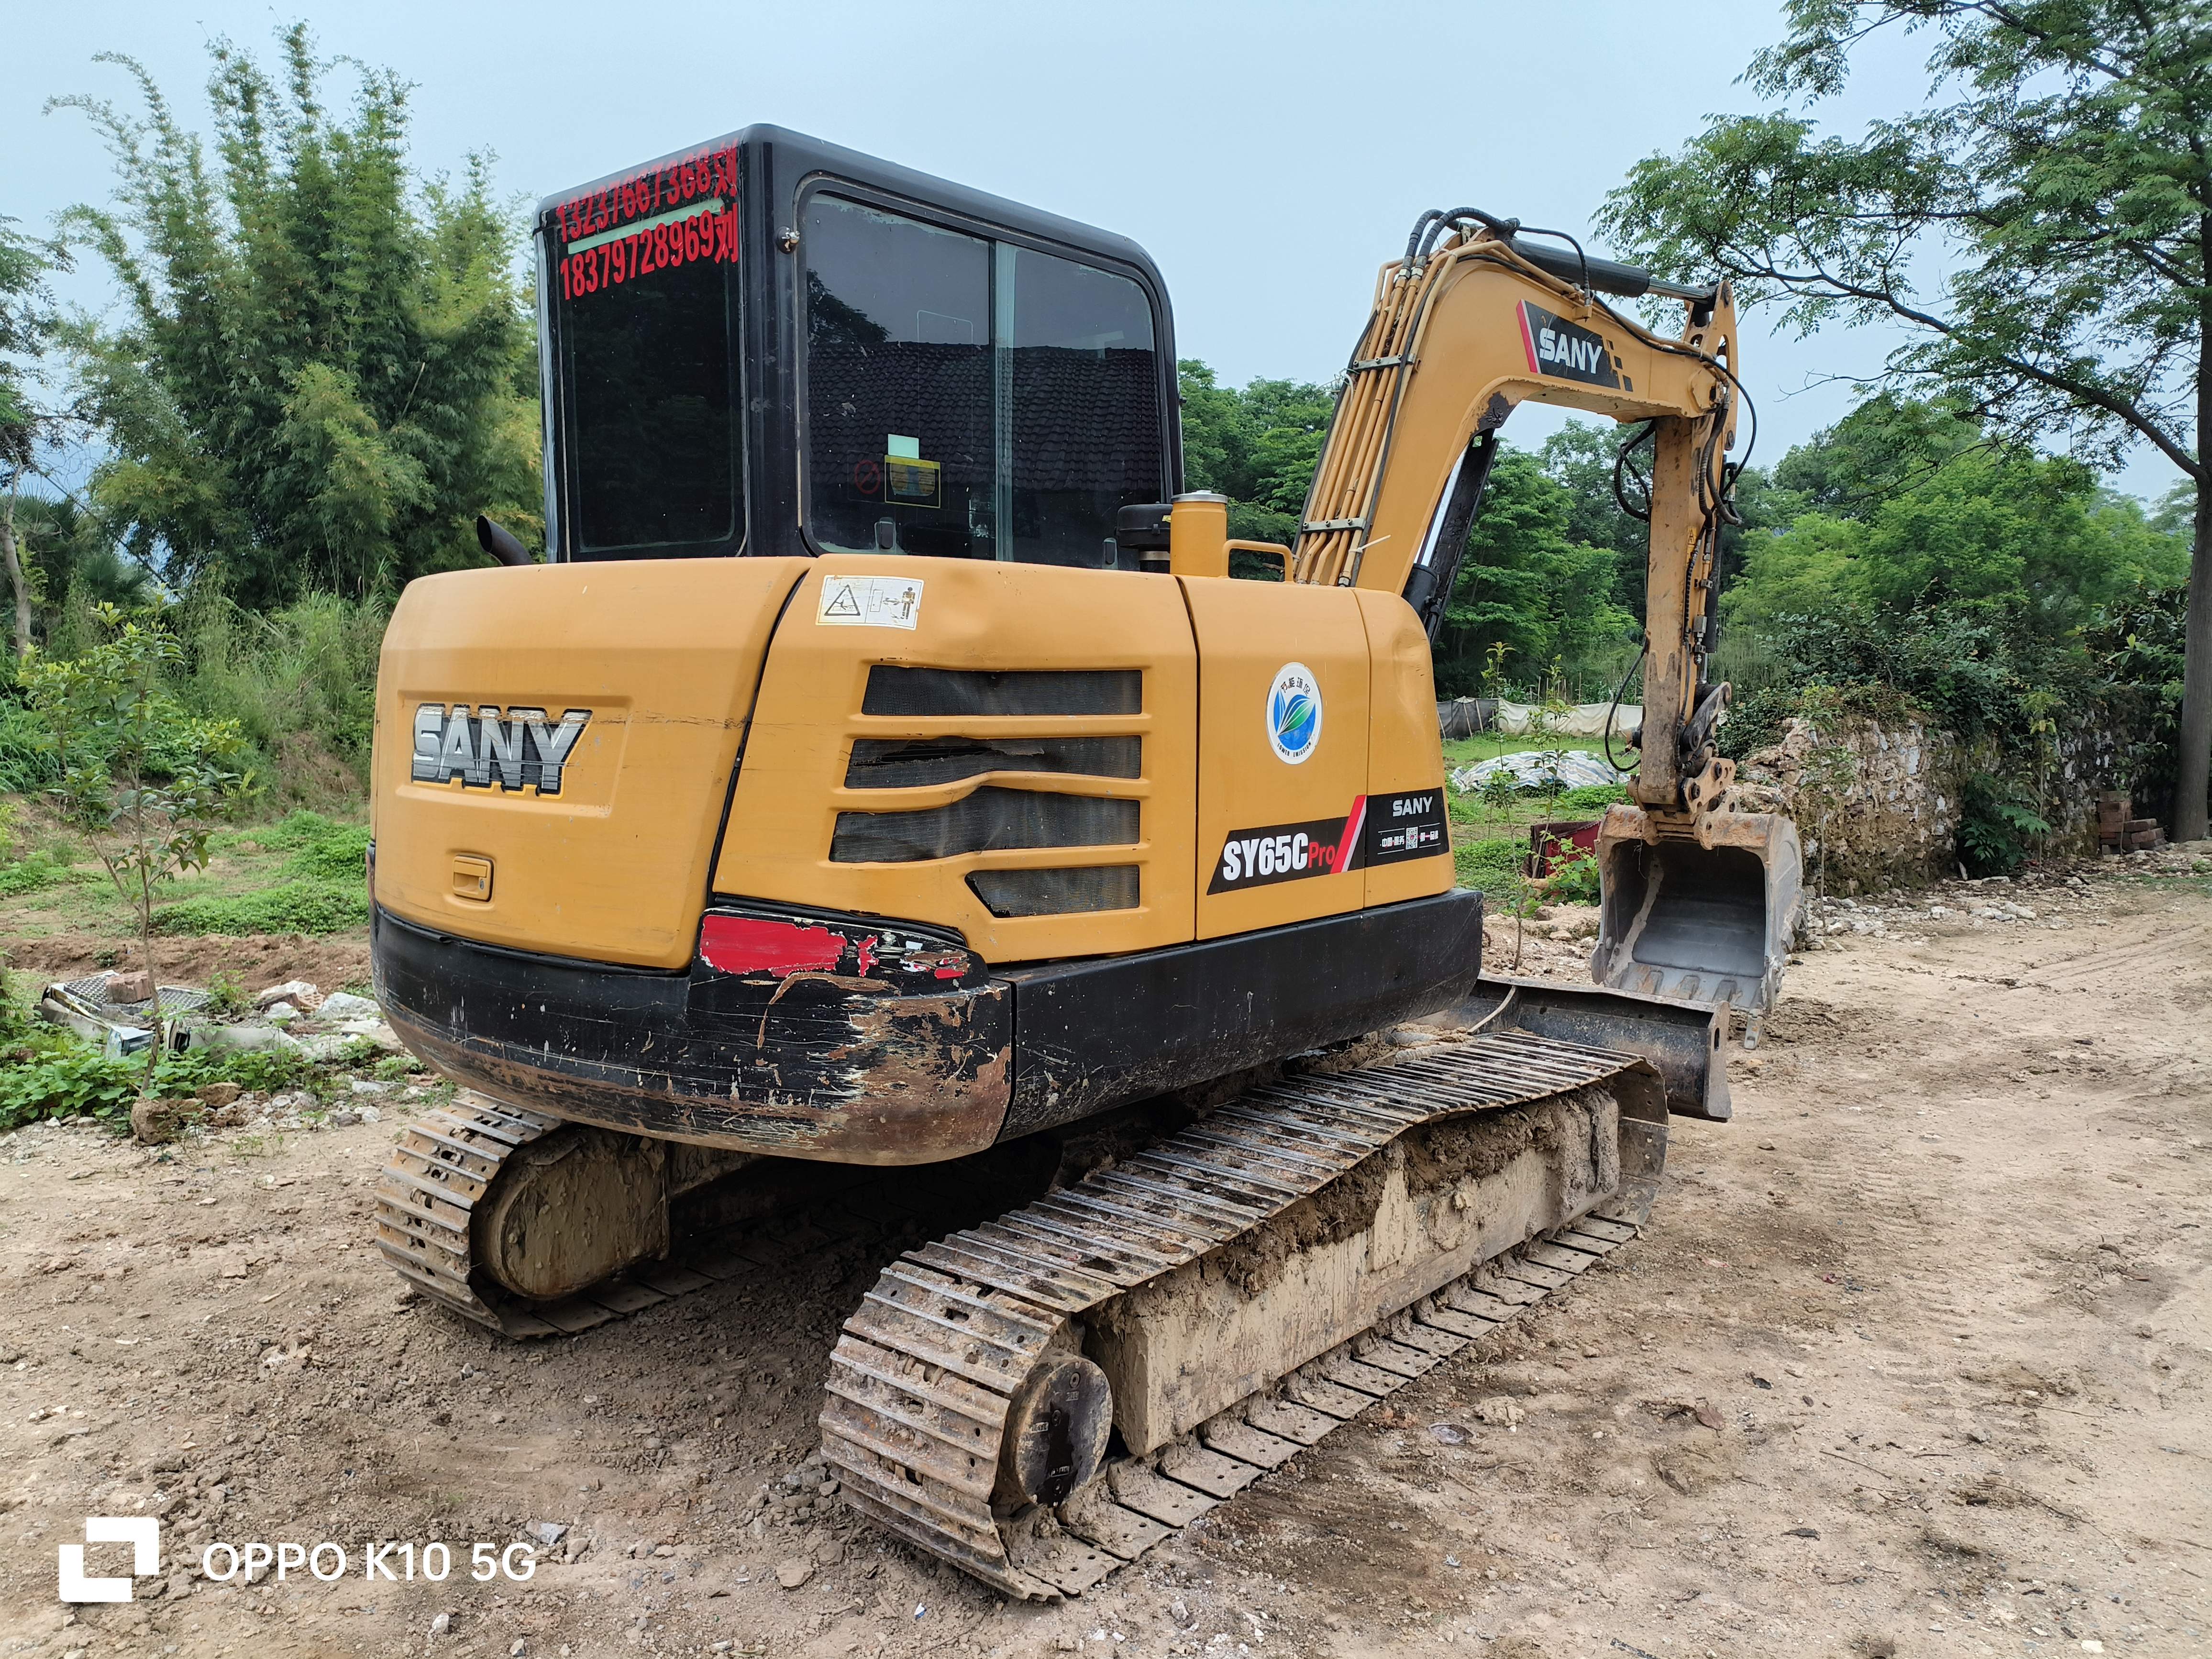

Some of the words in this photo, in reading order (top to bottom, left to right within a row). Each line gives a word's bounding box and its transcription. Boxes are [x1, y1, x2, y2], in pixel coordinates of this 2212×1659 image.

[560, 203, 739, 301] 18379728969刘
[1539, 328, 1603, 374] SANY
[1280, 676, 1311, 697] 节能环保
[412, 704, 593, 795] SANY
[1277, 742, 1290, 756] LOWER
[1393, 796, 1433, 817] SANY
